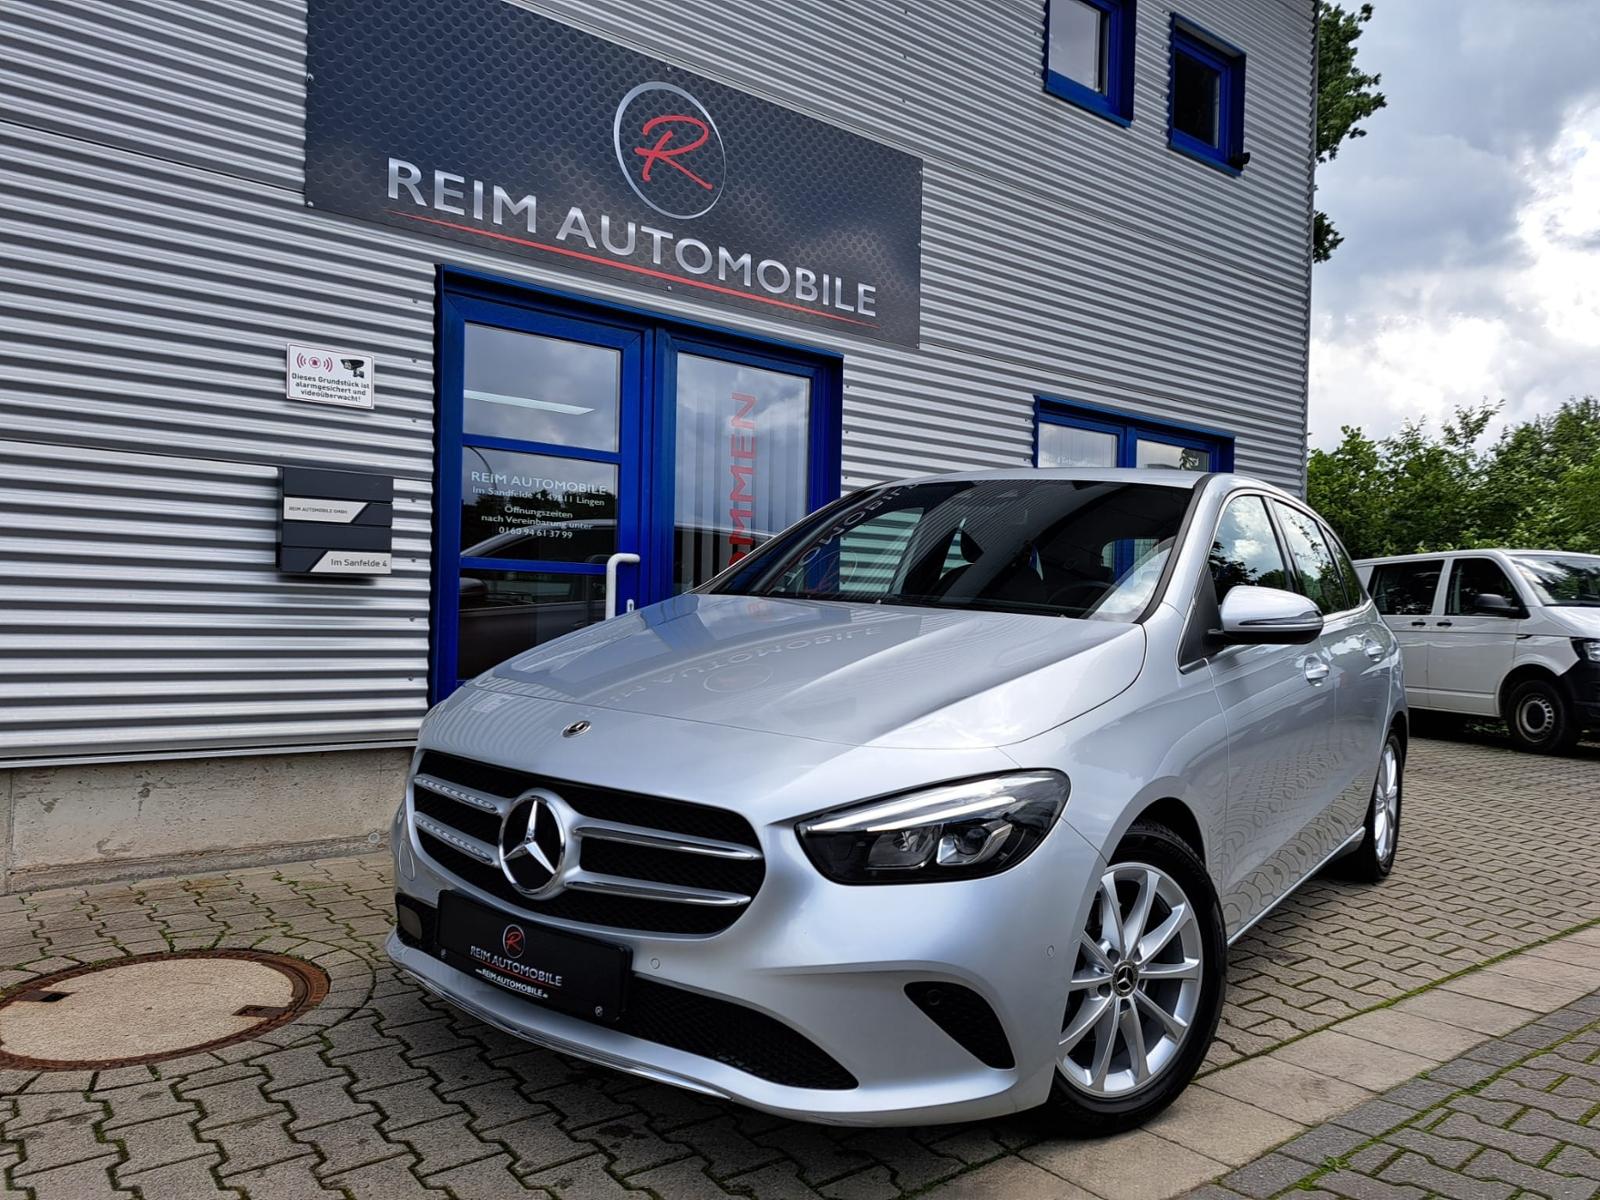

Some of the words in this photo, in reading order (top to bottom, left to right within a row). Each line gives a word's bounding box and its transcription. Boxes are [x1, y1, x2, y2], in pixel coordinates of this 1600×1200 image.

[634, 114, 713, 191] R
[387, 157, 538, 233] REIM
[556, 206, 877, 317] AUTOMOBILE
[291, 372, 316, 382] Dieses
[318, 376, 359, 388] Grundstück
[360, 382, 370, 390] ist
[295, 381, 351, 394] alarmgesichert
[300, 389, 361, 402] videoüberwacht!
[471, 471, 507, 484] REIM
[510, 476, 608, 496] AUTOMOBILE
[472, 486, 486, 494] Im
[488, 487, 533, 500] Sandfelde
[576, 497, 605, 507] Lingen
[504, 504, 573, 519] Öffnungszeiten
[481, 515, 504, 523] nach
[505, 515, 567, 530] Vereinbarung
[569, 521, 592, 530] unter
[536, 529, 547, 538] 61
[549, 530, 561, 538] 37
[562, 531, 573, 539] 99
[330, 558, 342, 566] Im
[344, 558, 381, 567] Sanfelde
[470, 945, 491, 962] REIM
[491, 955, 563, 987] AUTOMOBILE
